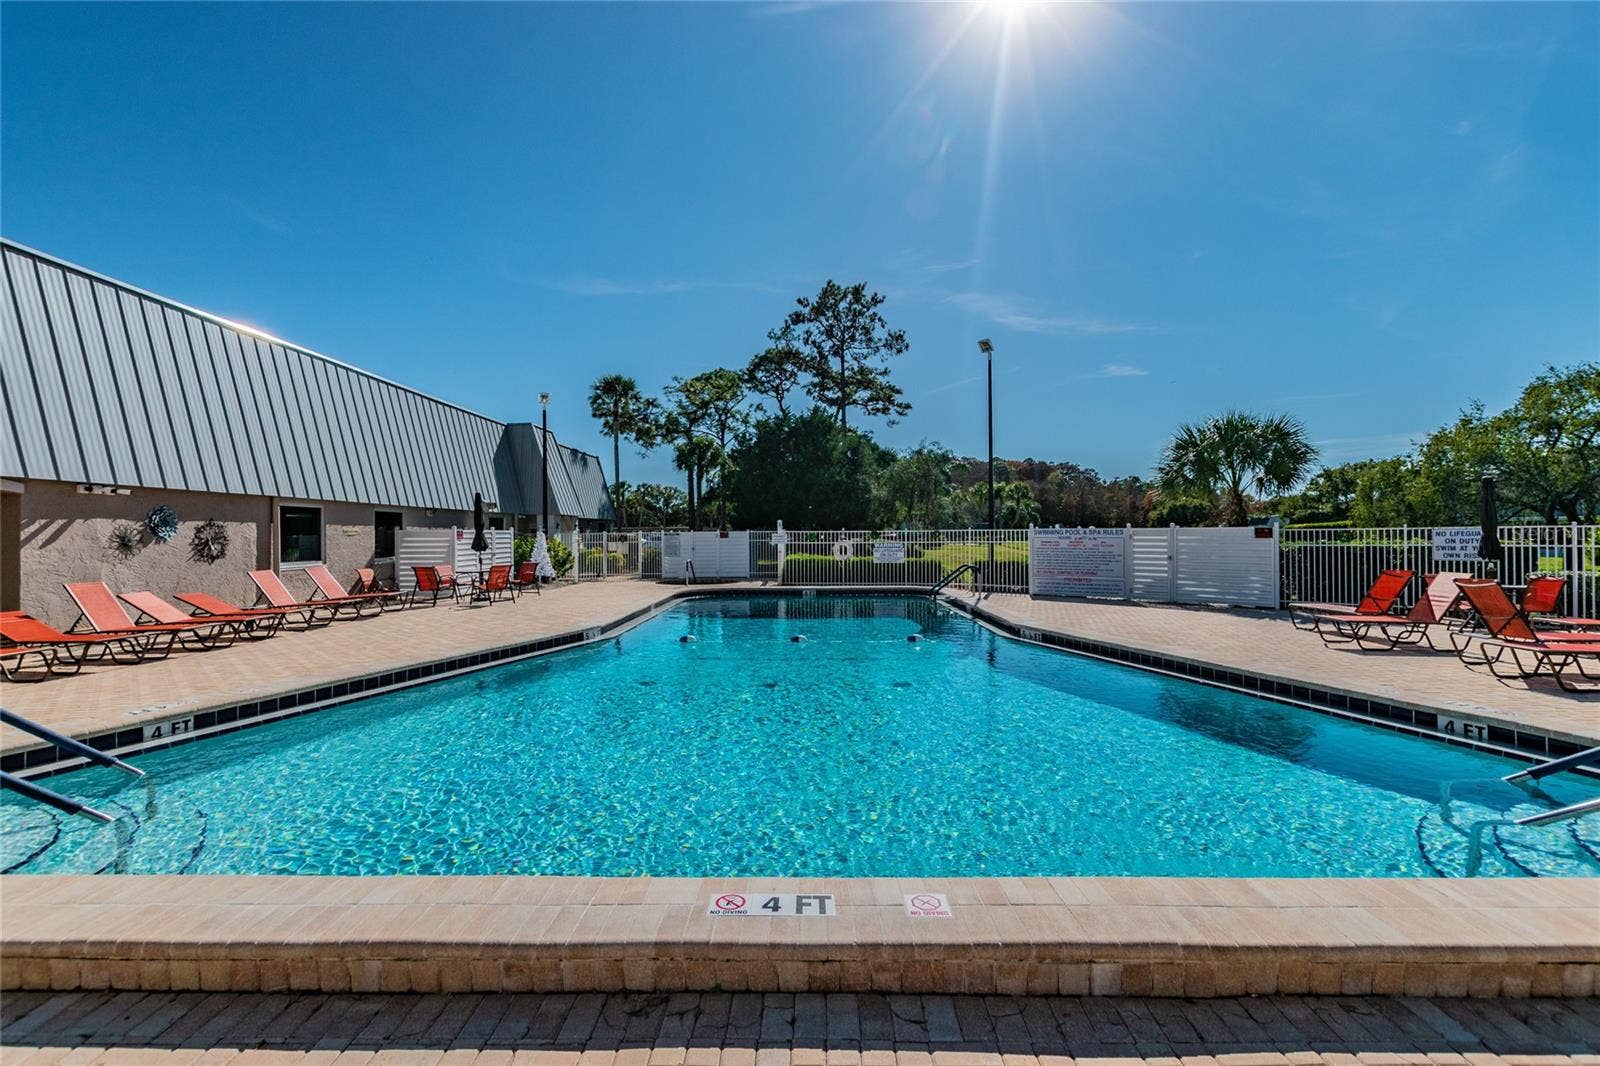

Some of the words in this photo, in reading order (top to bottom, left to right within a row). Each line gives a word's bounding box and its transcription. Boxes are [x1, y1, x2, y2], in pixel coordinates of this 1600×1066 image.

[151, 726, 162, 738] 4
[171, 719, 192, 735] FT
[1444, 720, 1456, 732] 4
[761, 896, 782, 912] 4
[795, 895, 832, 914] FT
